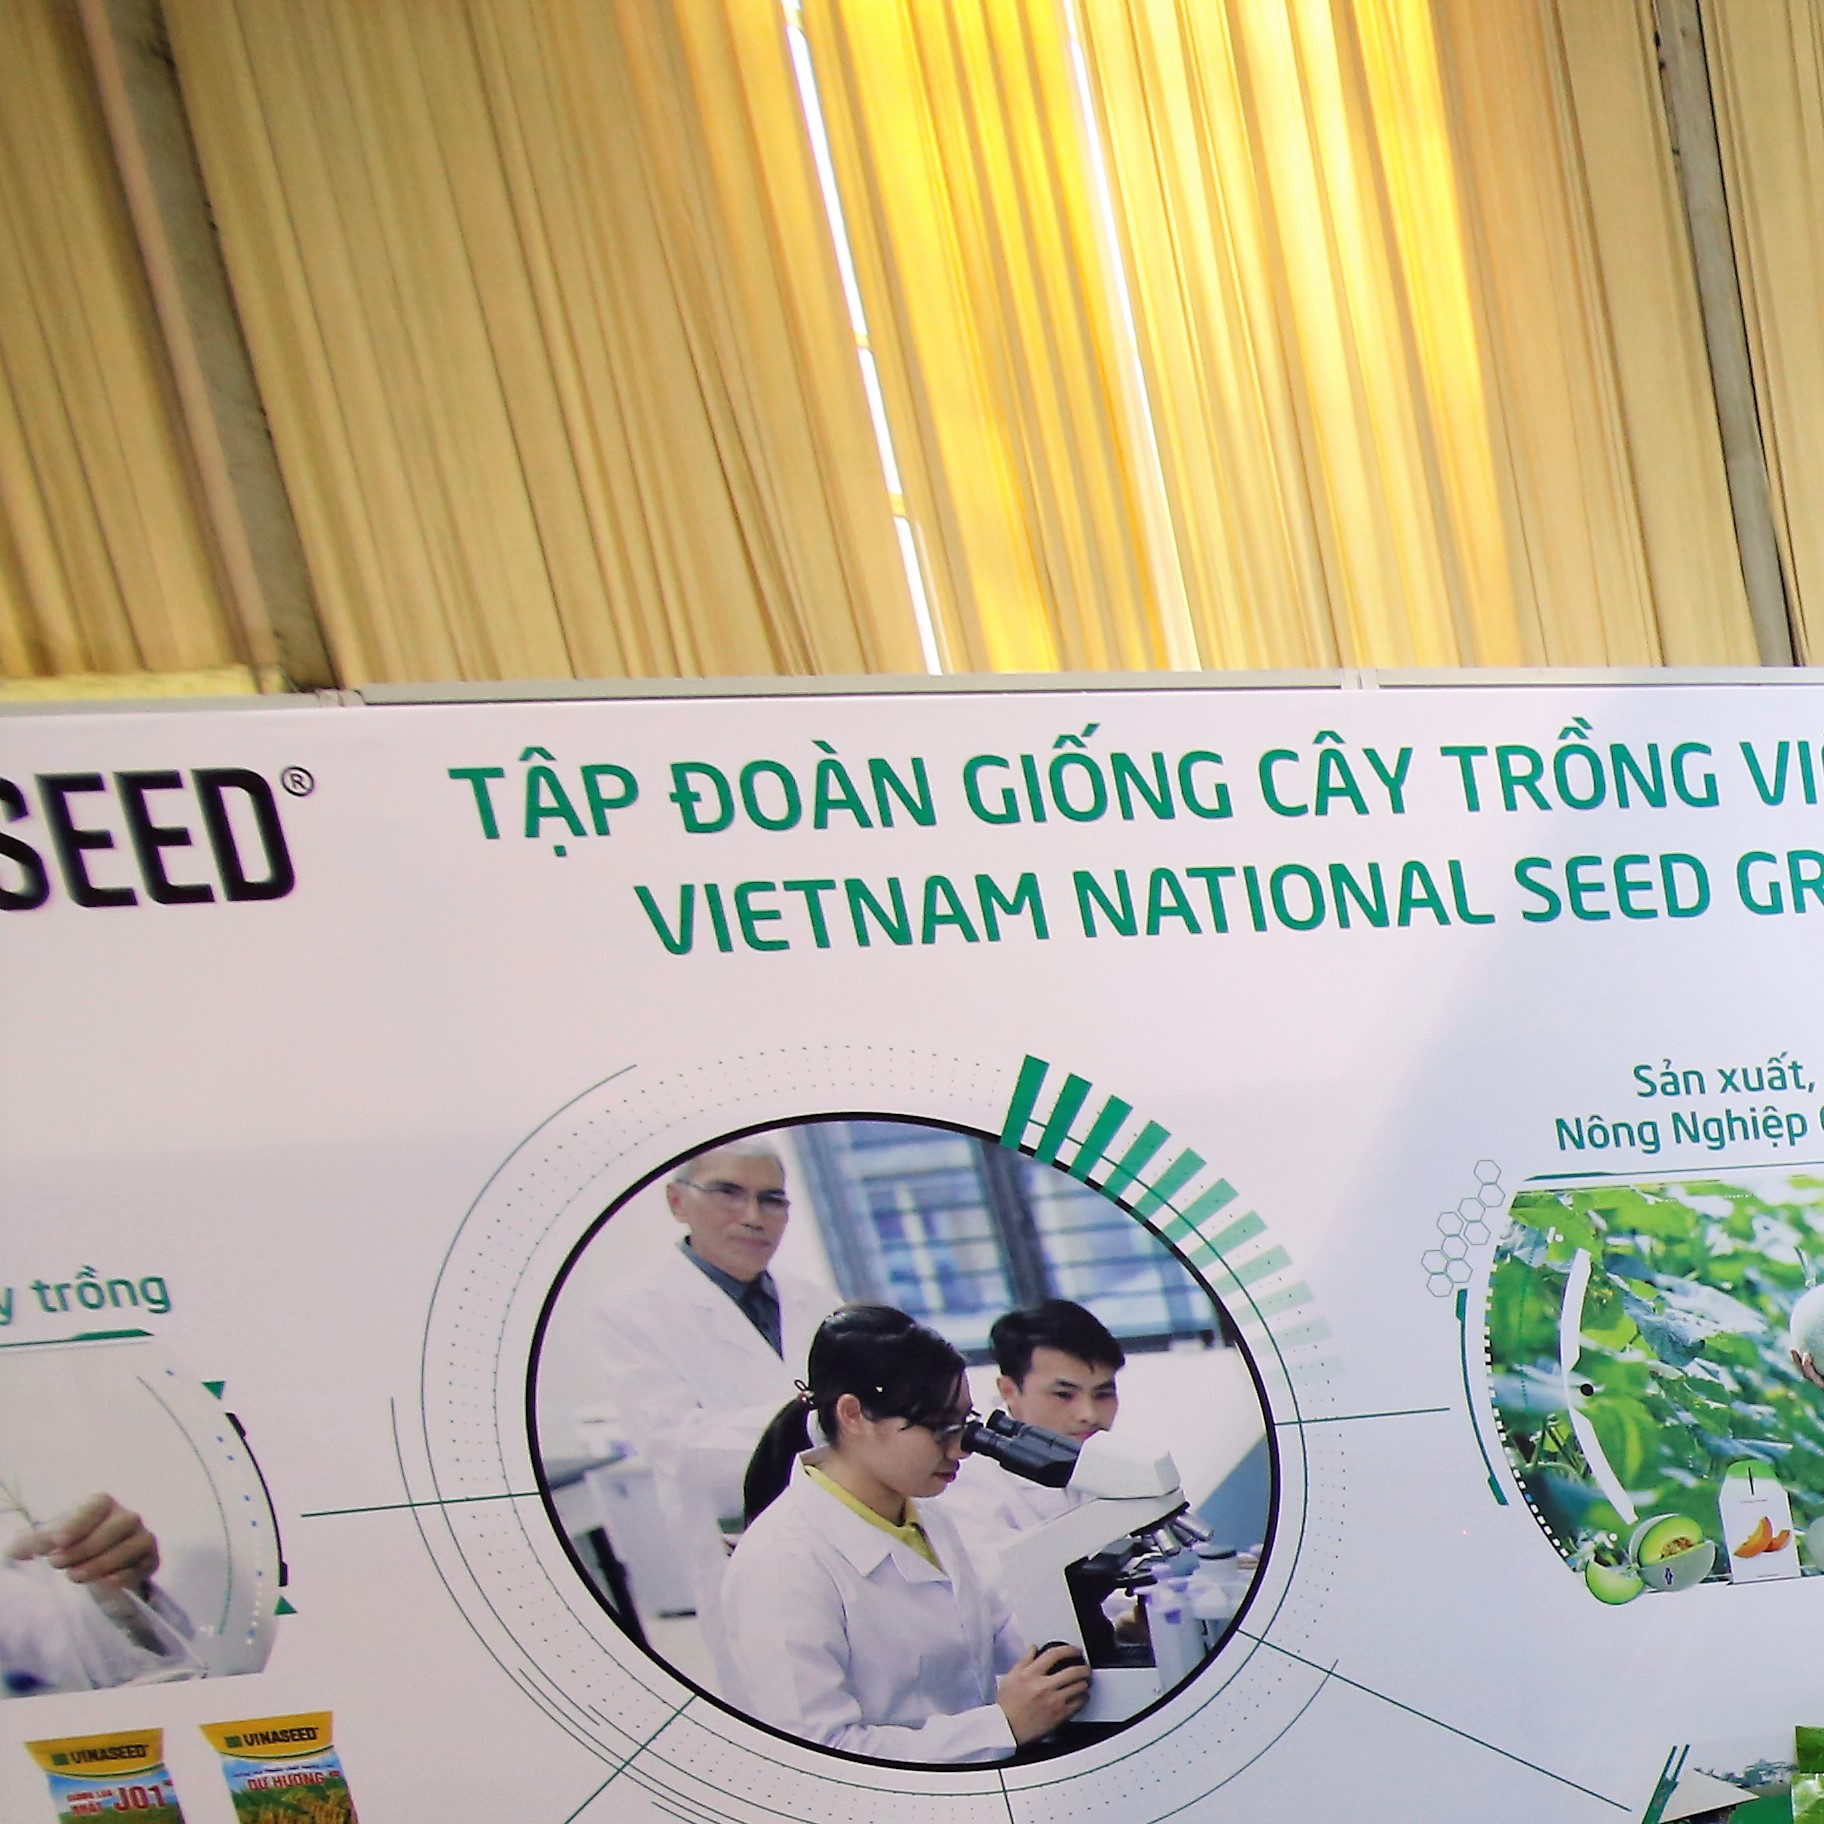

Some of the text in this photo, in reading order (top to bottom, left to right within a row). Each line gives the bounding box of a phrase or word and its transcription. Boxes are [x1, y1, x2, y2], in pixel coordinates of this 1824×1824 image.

[449, 745, 639, 859] TẬP
[668, 739, 938, 836] ĐOÀN
[960, 722, 1230, 827] GIỐNG
[1257, 730, 1415, 819] CÂY
[1440, 716, 1718, 813] TRỒNG
[633, 872, 1049, 957] VIETNAM
[1076, 857, 1495, 939] NATIONAL
[1512, 854, 1712, 924] SEED
[1631, 1060, 1709, 1100] Sản
[1718, 1052, 1816, 1096] xuất,
[1556, 1107, 1662, 1159] Nông
[1671, 1105, 1809, 1152] Nghiệp
[30, 1265, 173, 1315] trồng
[242, 1727, 317, 1748] VINASEED
